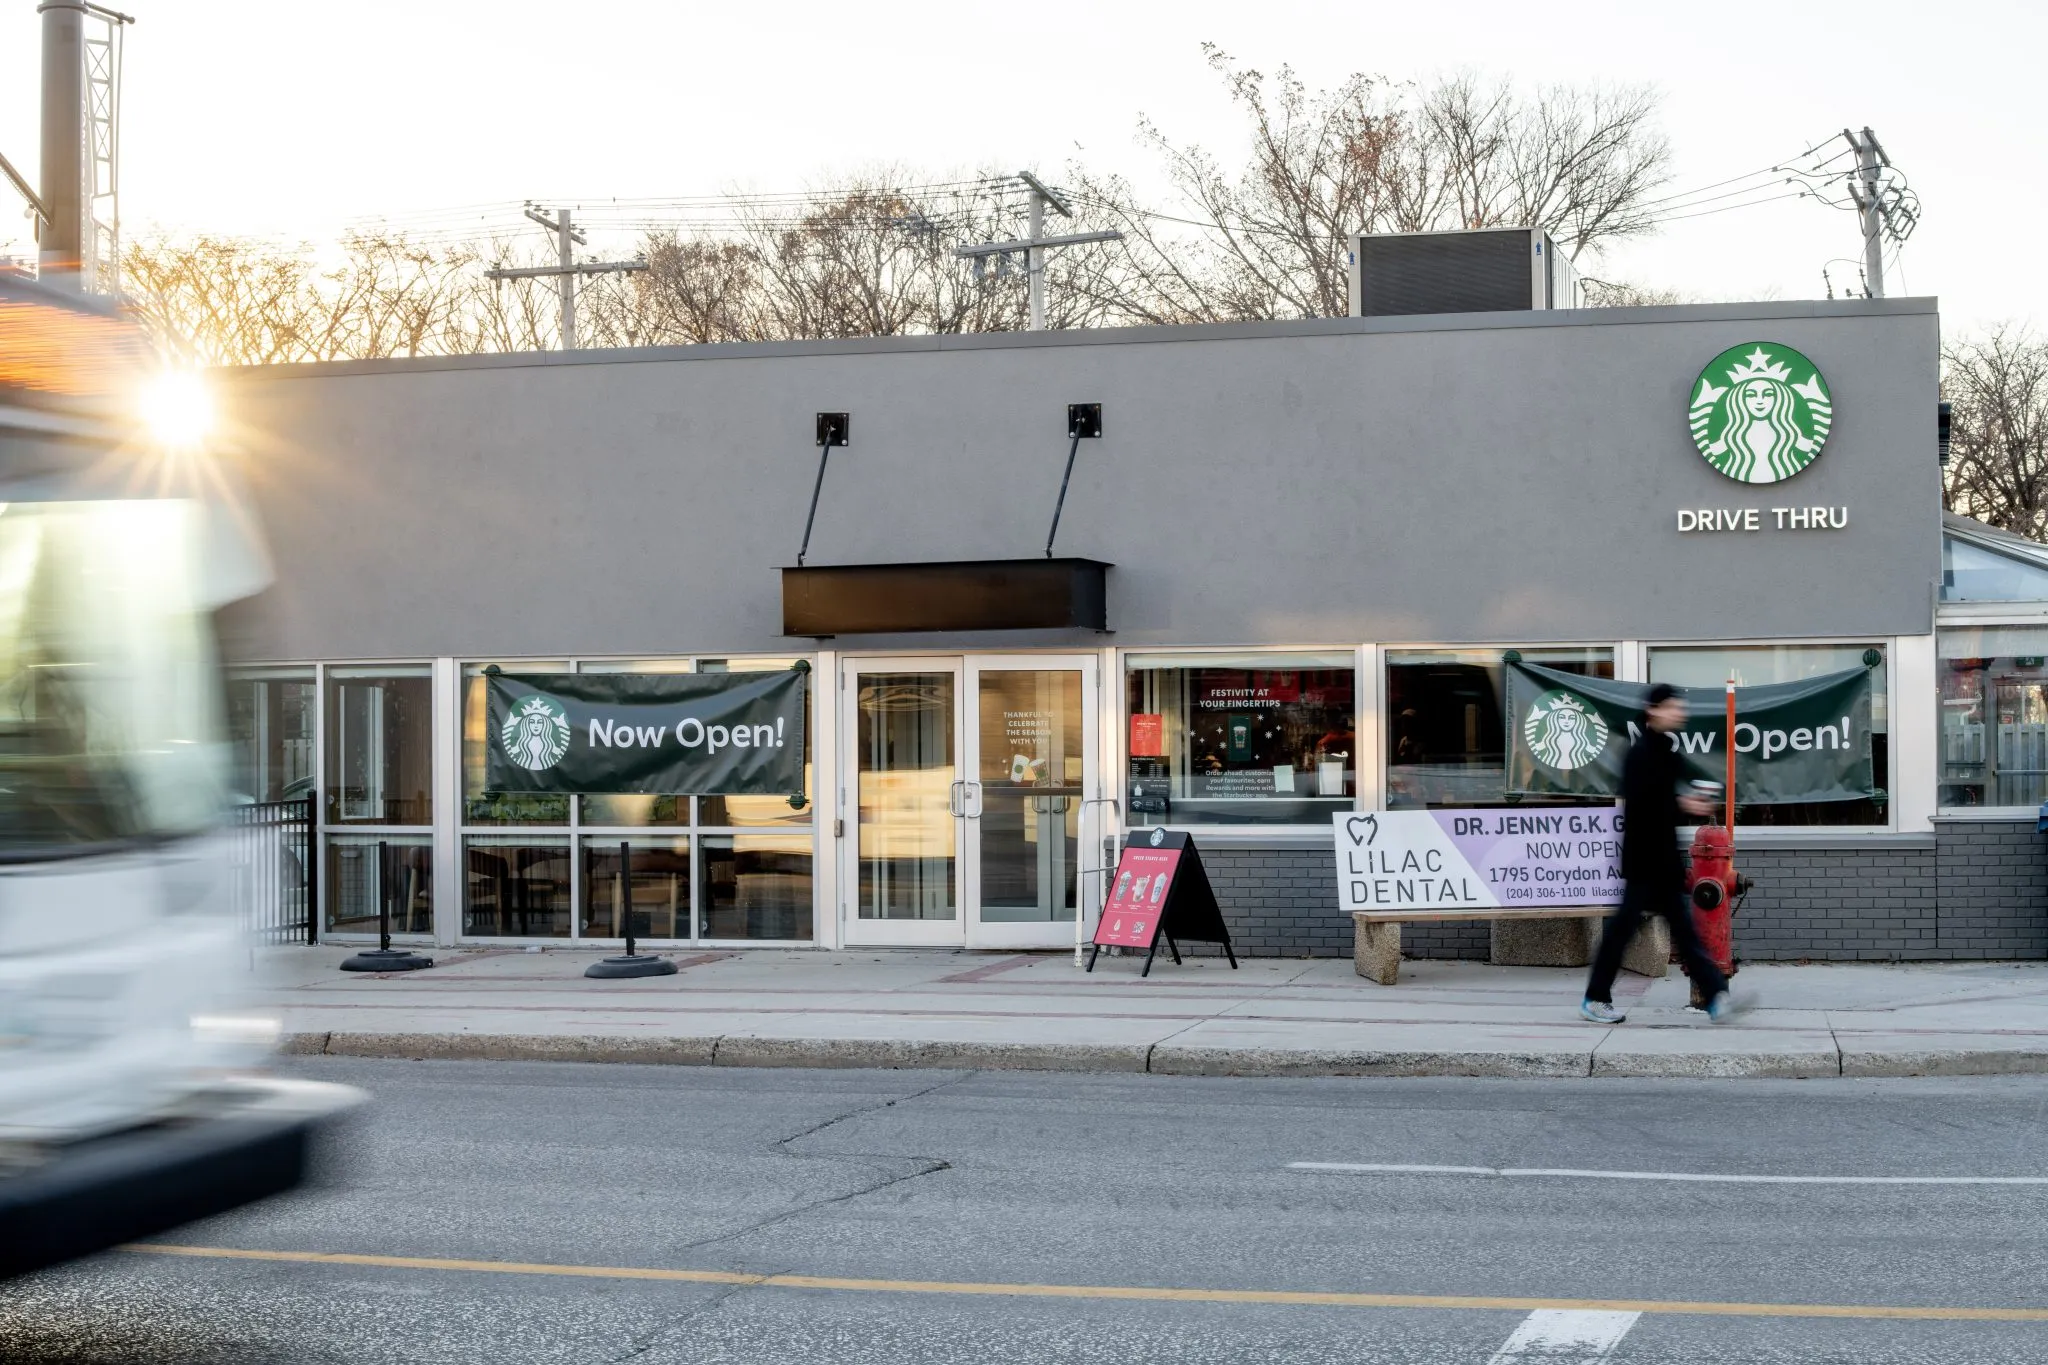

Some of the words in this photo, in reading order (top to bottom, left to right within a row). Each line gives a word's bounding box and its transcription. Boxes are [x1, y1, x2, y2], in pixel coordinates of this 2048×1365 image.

[1678, 508, 1760, 531] DRIVE
[1771, 506, 1848, 529] THRU
[1211, 688, 1255, 697] FESTIVITY
[1257, 688, 1270, 697] AT
[1200, 700, 1225, 708] YOUR
[1227, 699, 1281, 708] FINGERTIPS
[1003, 711, 1043, 719] THANKFUL
[589, 718, 666, 748] Now
[676, 716, 785, 754] Open!
[1733, 715, 1852, 760] Open!
[1454, 817, 1490, 836] DR.
[1494, 815, 1563, 835] JENNY
[1569, 815, 1607, 833] G.K.
[1526, 841, 1572, 859] NOW
[1578, 840, 1624, 859] OPEN
[1349, 849, 1442, 874] LILAC
[1489, 867, 1530, 883] 1795
[1535, 866, 1601, 884] Corydon
[1351, 878, 1477, 904] DENTAL
[1506, 887, 1533, 899] (204)
[1536, 886, 1586, 898] 306-1100
